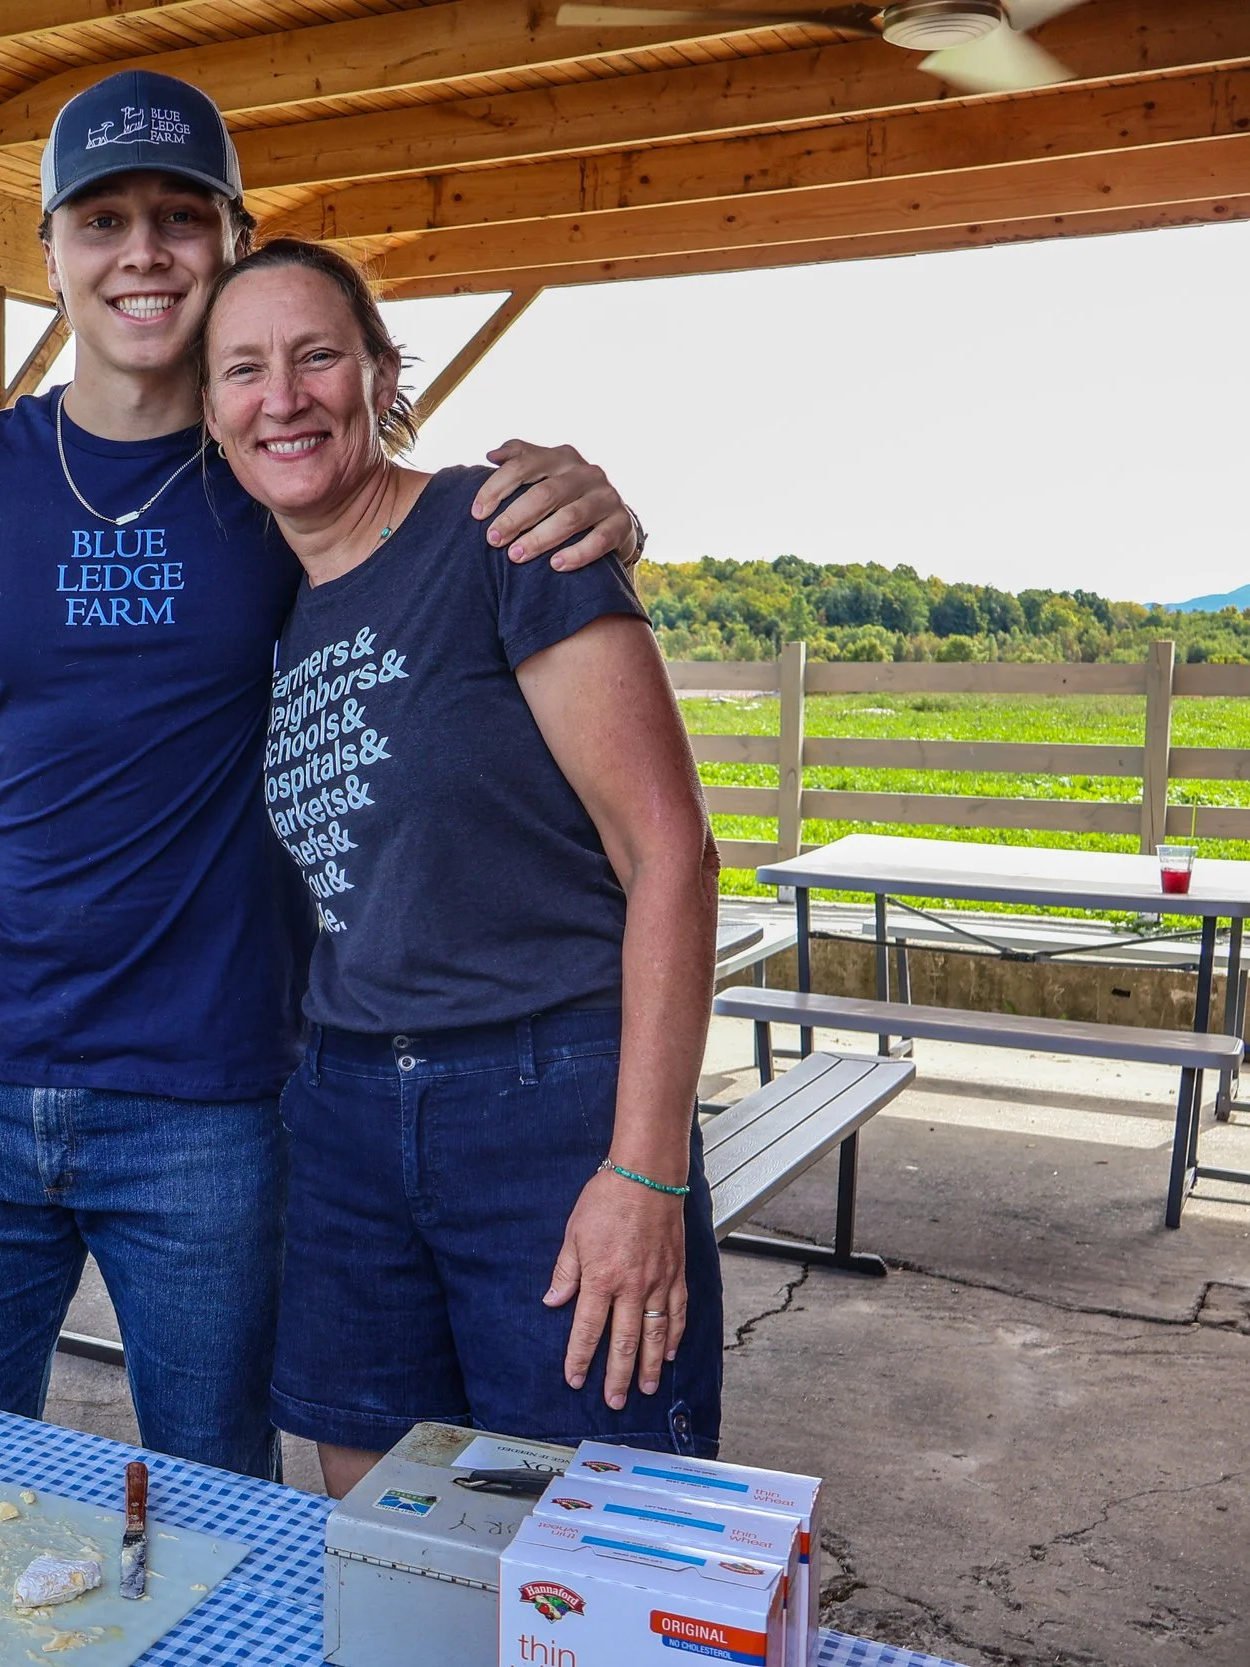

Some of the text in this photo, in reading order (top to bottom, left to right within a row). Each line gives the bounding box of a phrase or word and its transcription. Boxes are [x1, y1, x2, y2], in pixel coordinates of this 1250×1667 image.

[151, 108, 181, 122] BLUE
[150, 130, 186, 145] FARM
[151, 121, 191, 135] LEDGE
[71, 529, 167, 558] BLUE
[56, 562, 185, 592] LEDGE
[65, 596, 176, 626] FARM
[282, 820, 359, 868] hefs&
[302, 861, 355, 899] ou&
[752, 1495, 795, 1507] wheat
[754, 1488, 780, 1498] thin
[538, 1521, 579, 1534] wheat
[550, 1529, 578, 1540] thin
[731, 1528, 758, 1540] thin
[729, 1534, 773, 1550] wheat
[526, 1584, 579, 1607] Hannaford
[661, 1617, 729, 1645] ORIGINAL
[517, 1633, 576, 1667] thin
[669, 1638, 734, 1661] NO CHOLESTEROL
